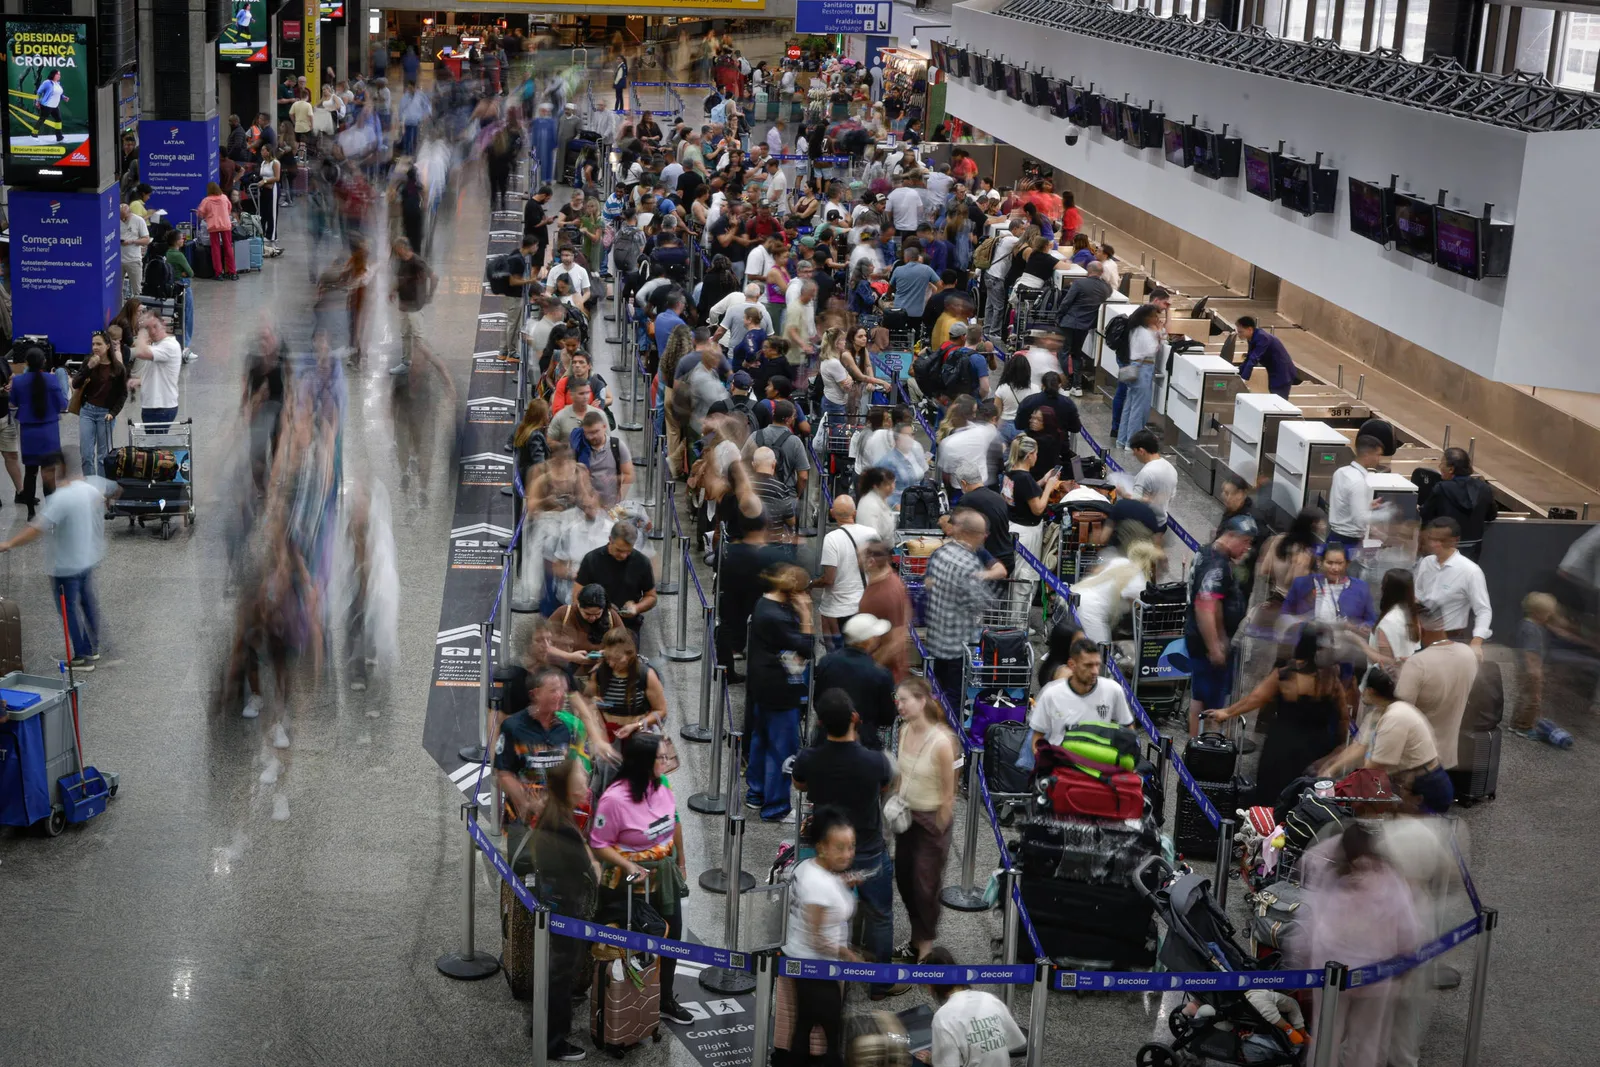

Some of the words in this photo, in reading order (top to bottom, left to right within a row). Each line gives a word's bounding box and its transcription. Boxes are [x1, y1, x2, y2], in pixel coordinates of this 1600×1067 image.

[14, 32, 75, 43] OBESIDADE
[15, 42, 22, 54] É
[24, 44, 76, 58] DOENÇA
[149, 153, 176, 161] Começa
[178, 154, 195, 162] aqui!
[22, 235, 58, 246] Começa
[60, 236, 82, 247] aqui!
[551, 921, 565, 929] olar
[598, 930, 628, 942] decolar
[660, 943, 691, 955] decolar
[843, 966, 876, 976] decolar
[912, 970, 944, 979] decolar
[981, 970, 1013, 979] decolar
[970, 1014, 1002, 1032] three
[686, 1024, 755, 1039] Conexõe
[966, 1027, 1002, 1046] stripes
[697, 1041, 731, 1051] Flight
[705, 1046, 753, 1059] connecti
[712, 1056, 753, 1067] Conexi
